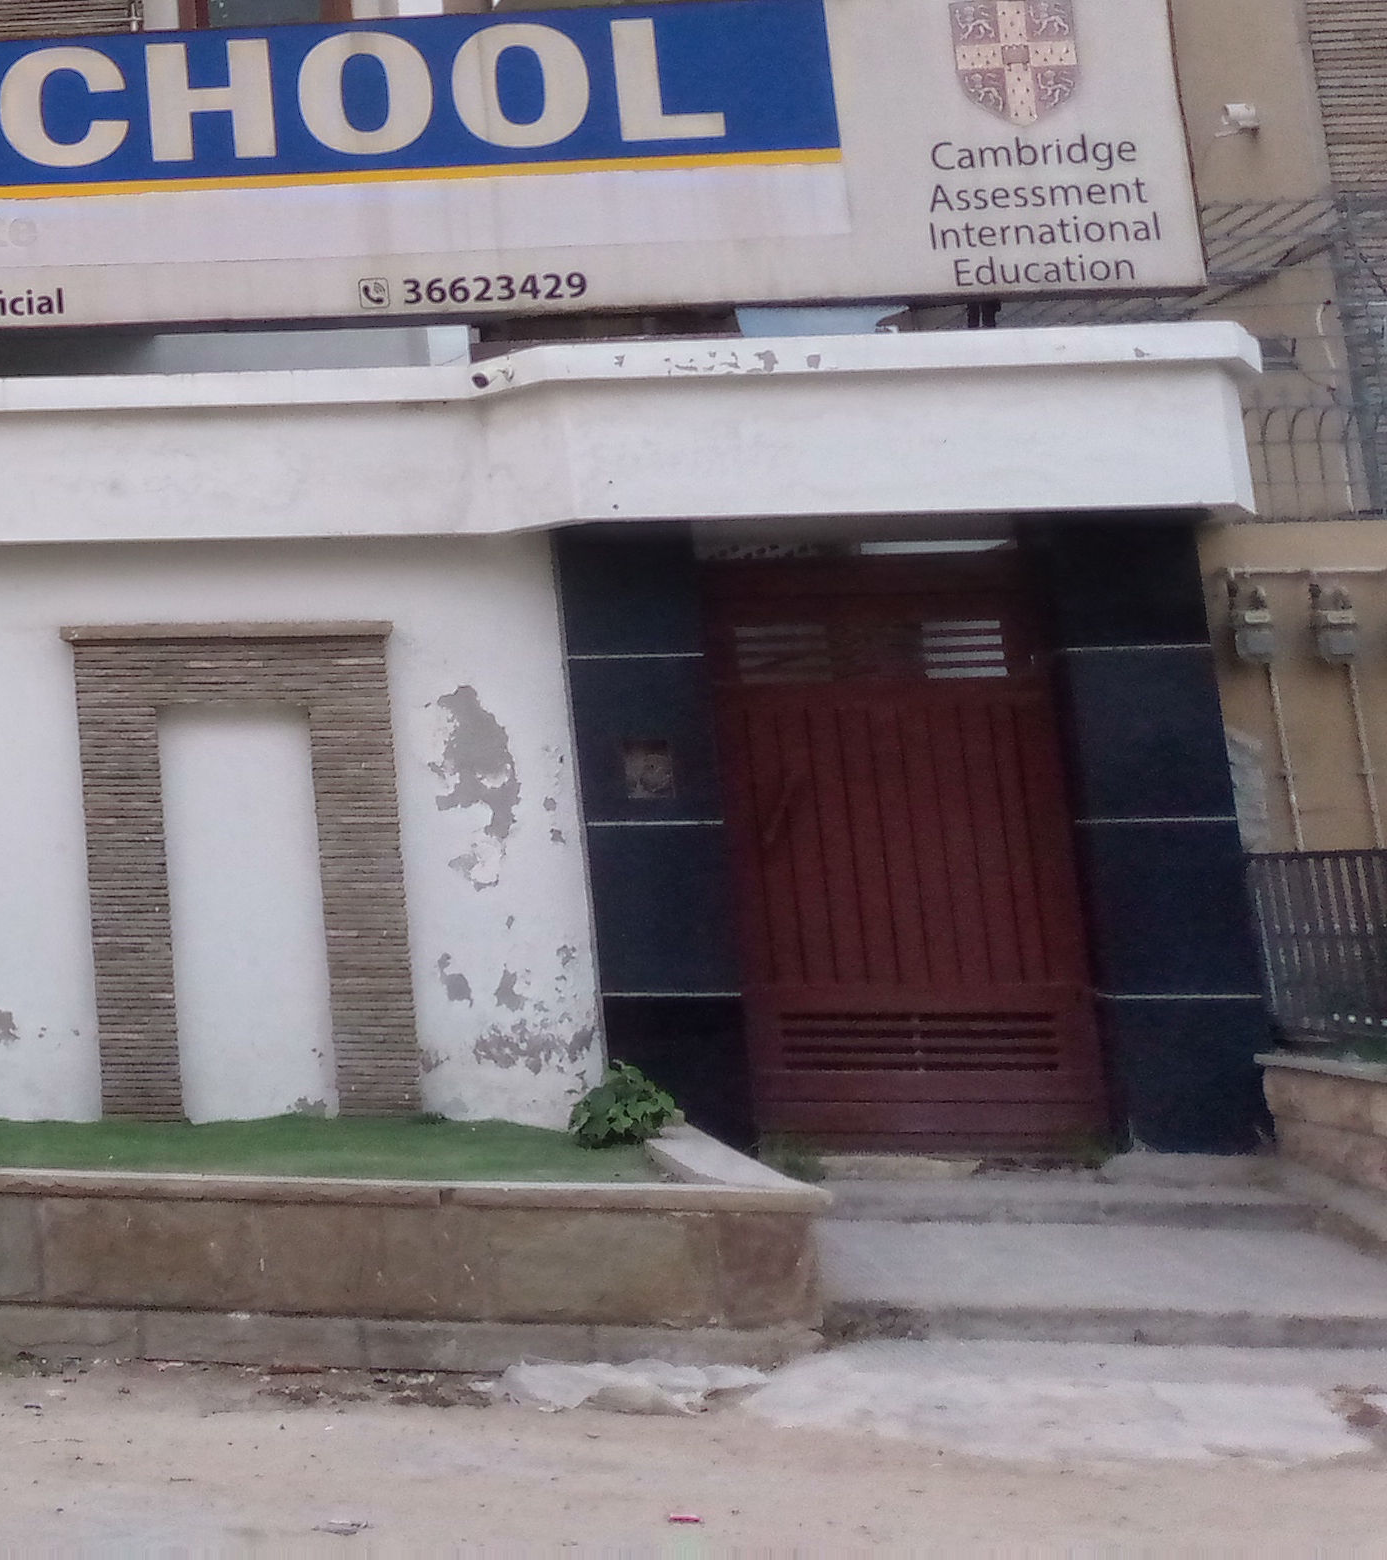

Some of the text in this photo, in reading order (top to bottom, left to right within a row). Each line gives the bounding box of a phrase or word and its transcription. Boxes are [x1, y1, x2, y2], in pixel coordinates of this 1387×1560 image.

[930, 133, 1137, 171] Cambridge
[929, 177, 1149, 213] Assessment
[929, 211, 1162, 251] International
[402, 271, 588, 305] 36623429
[953, 254, 1136, 287] Education
